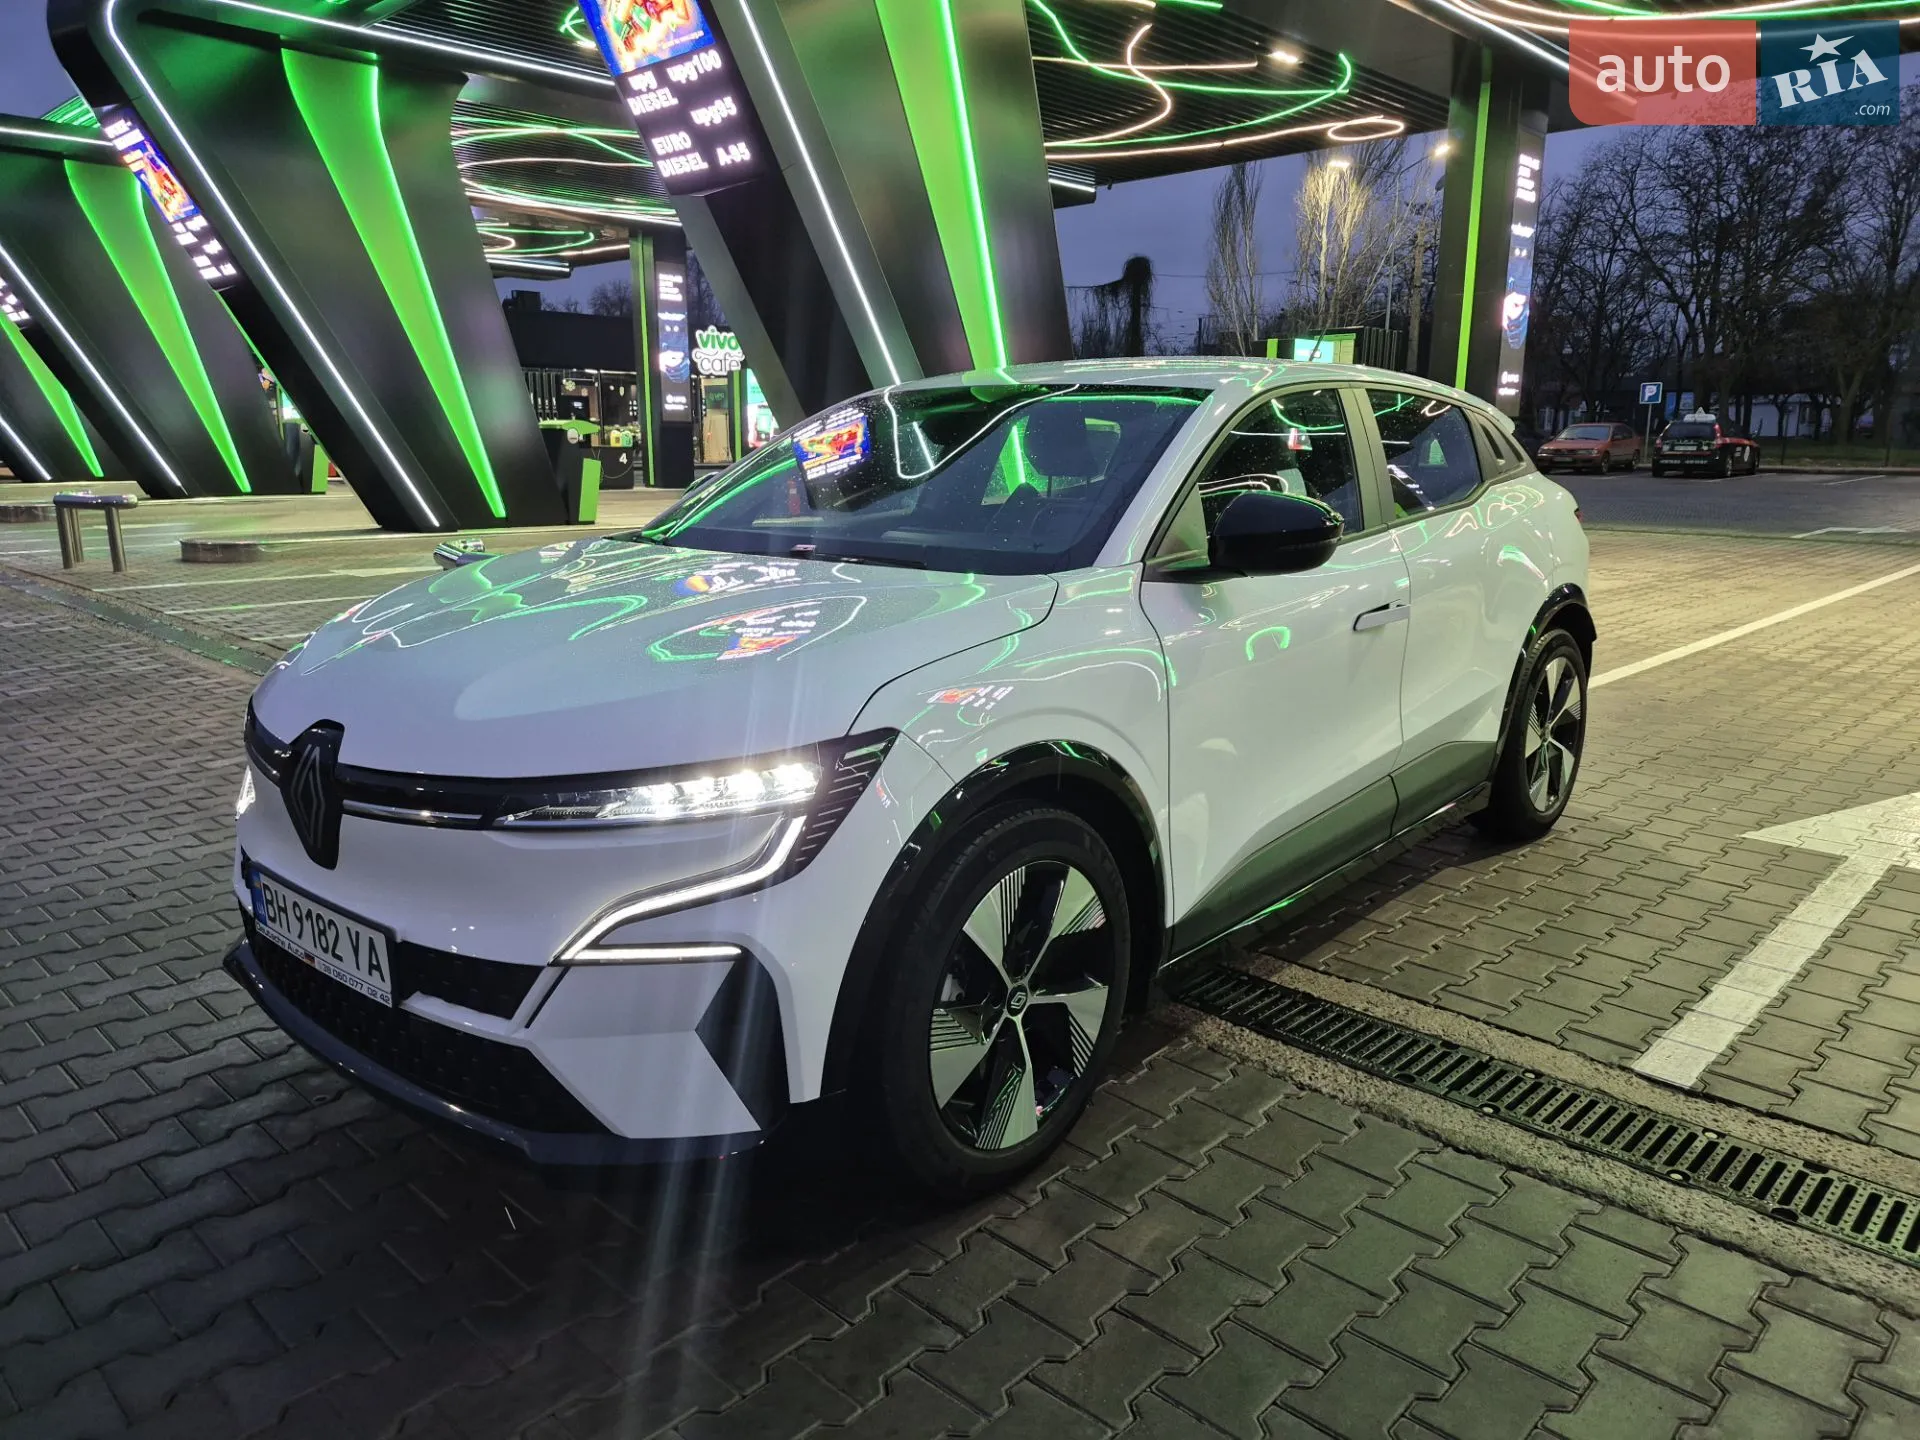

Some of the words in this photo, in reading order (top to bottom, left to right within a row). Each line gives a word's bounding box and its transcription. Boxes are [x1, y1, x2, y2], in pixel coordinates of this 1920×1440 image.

[666, 49, 722, 84] upg100
[627, 87, 679, 116] DIESEL
[651, 131, 692, 156] EURO
[657, 152, 709, 178] DIESEL
[699, 327, 739, 350] vivo
[1645, 384, 1657, 402] P
[619, 453, 628, 464] 4
[262, 883, 291, 934] BH
[293, 900, 344, 963] 9182
[346, 926, 386, 984] YA
[287, 943, 305, 960] Auto
[332, 969, 348, 985] 050
[349, 977, 364, 992] 077
[380, 993, 391, 1004] 42
